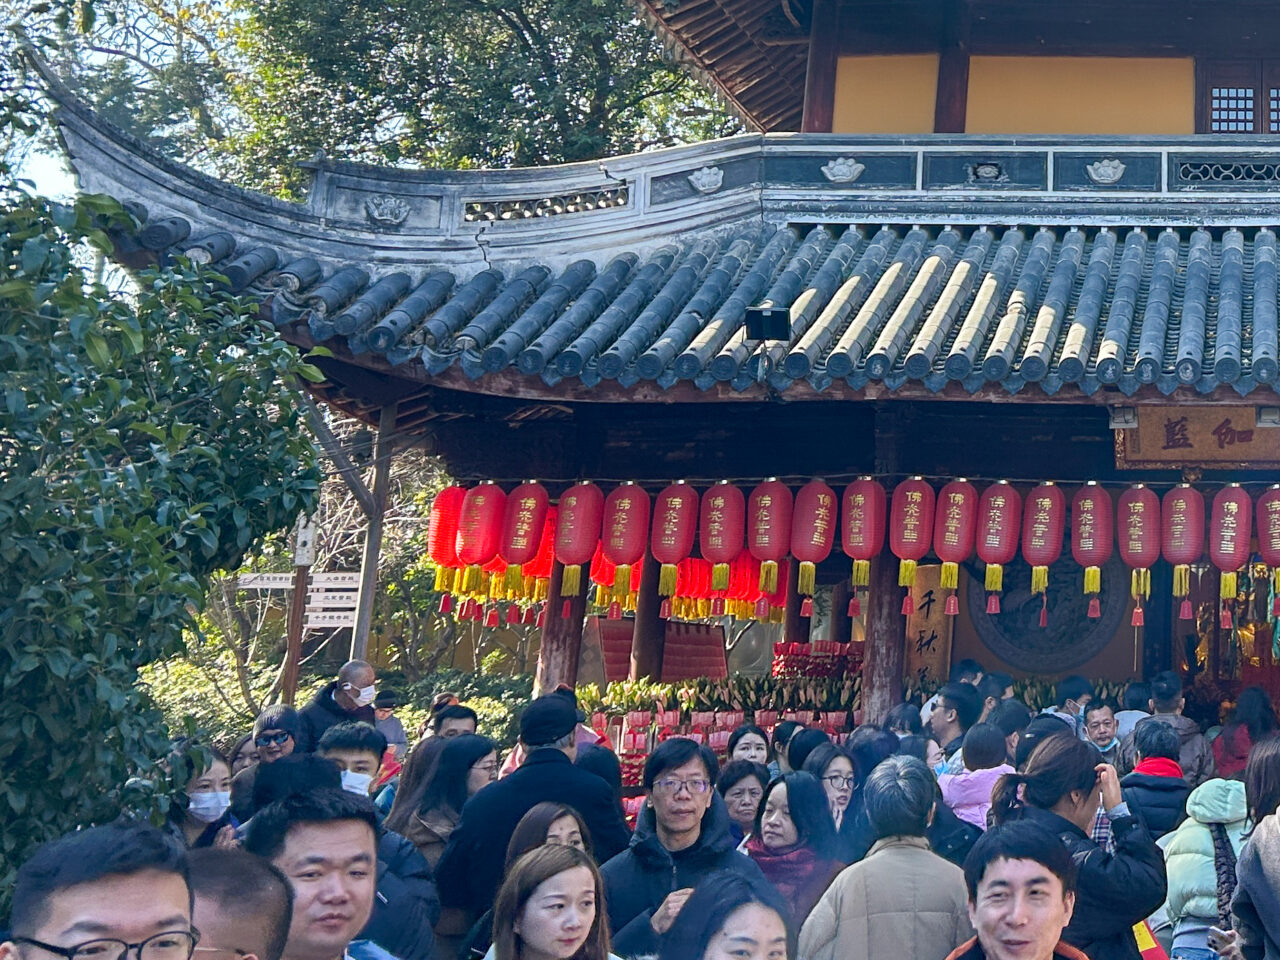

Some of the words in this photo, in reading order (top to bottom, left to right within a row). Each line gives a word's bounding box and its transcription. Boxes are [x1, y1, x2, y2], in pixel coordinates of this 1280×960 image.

[810, 493, 832, 547] 佛光普照
[902, 491, 923, 542] 佛光普照
[943, 492, 965, 546] 佛光普照
[985, 496, 1006, 547] 佛光普照
[1031, 498, 1053, 548] 佛光普照
[1078, 499, 1094, 550] 佛光普照
[916, 589, 938, 681] 千秋
